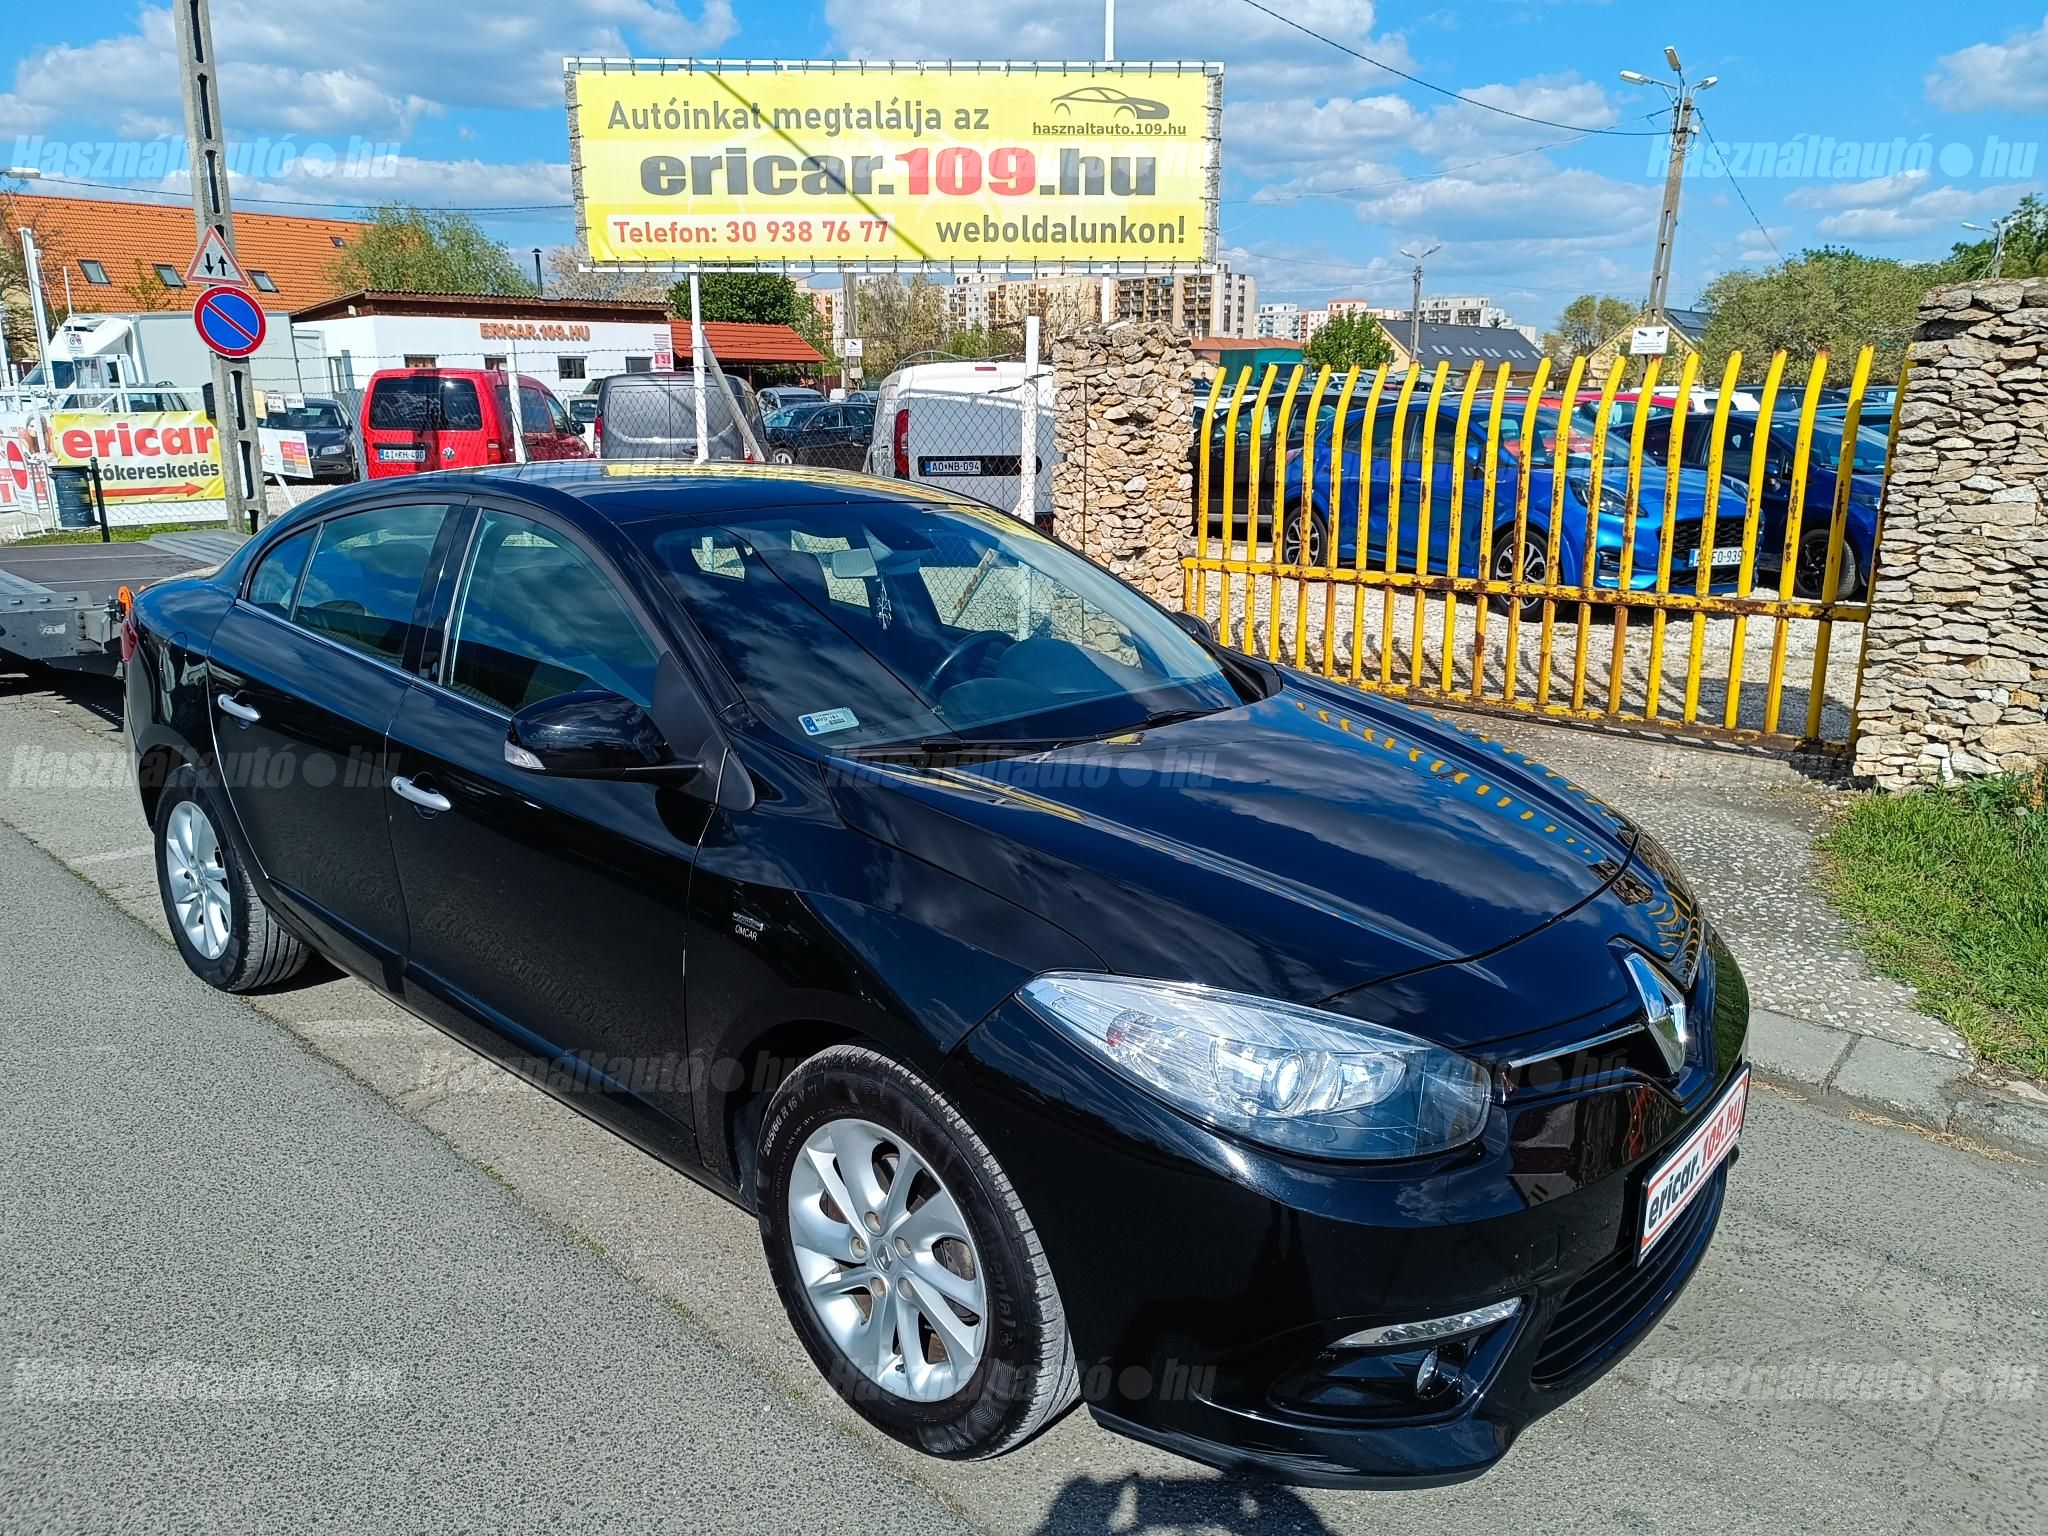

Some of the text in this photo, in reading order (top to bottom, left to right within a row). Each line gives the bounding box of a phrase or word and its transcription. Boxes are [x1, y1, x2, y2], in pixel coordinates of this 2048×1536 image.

[607, 97, 990, 137] Autóinkat megtalálja az
[1032, 122, 1187, 136] hasznaltauto.109.hu
[640, 147, 1157, 197] ericar.109.hu
[613, 220, 889, 244] Telefon: 30 938 76 77
[936, 215, 1186, 244] weboldalunkon!
[480, 323, 590, 341] ERICAR.109.HU
[62, 423, 215, 458] ericar
